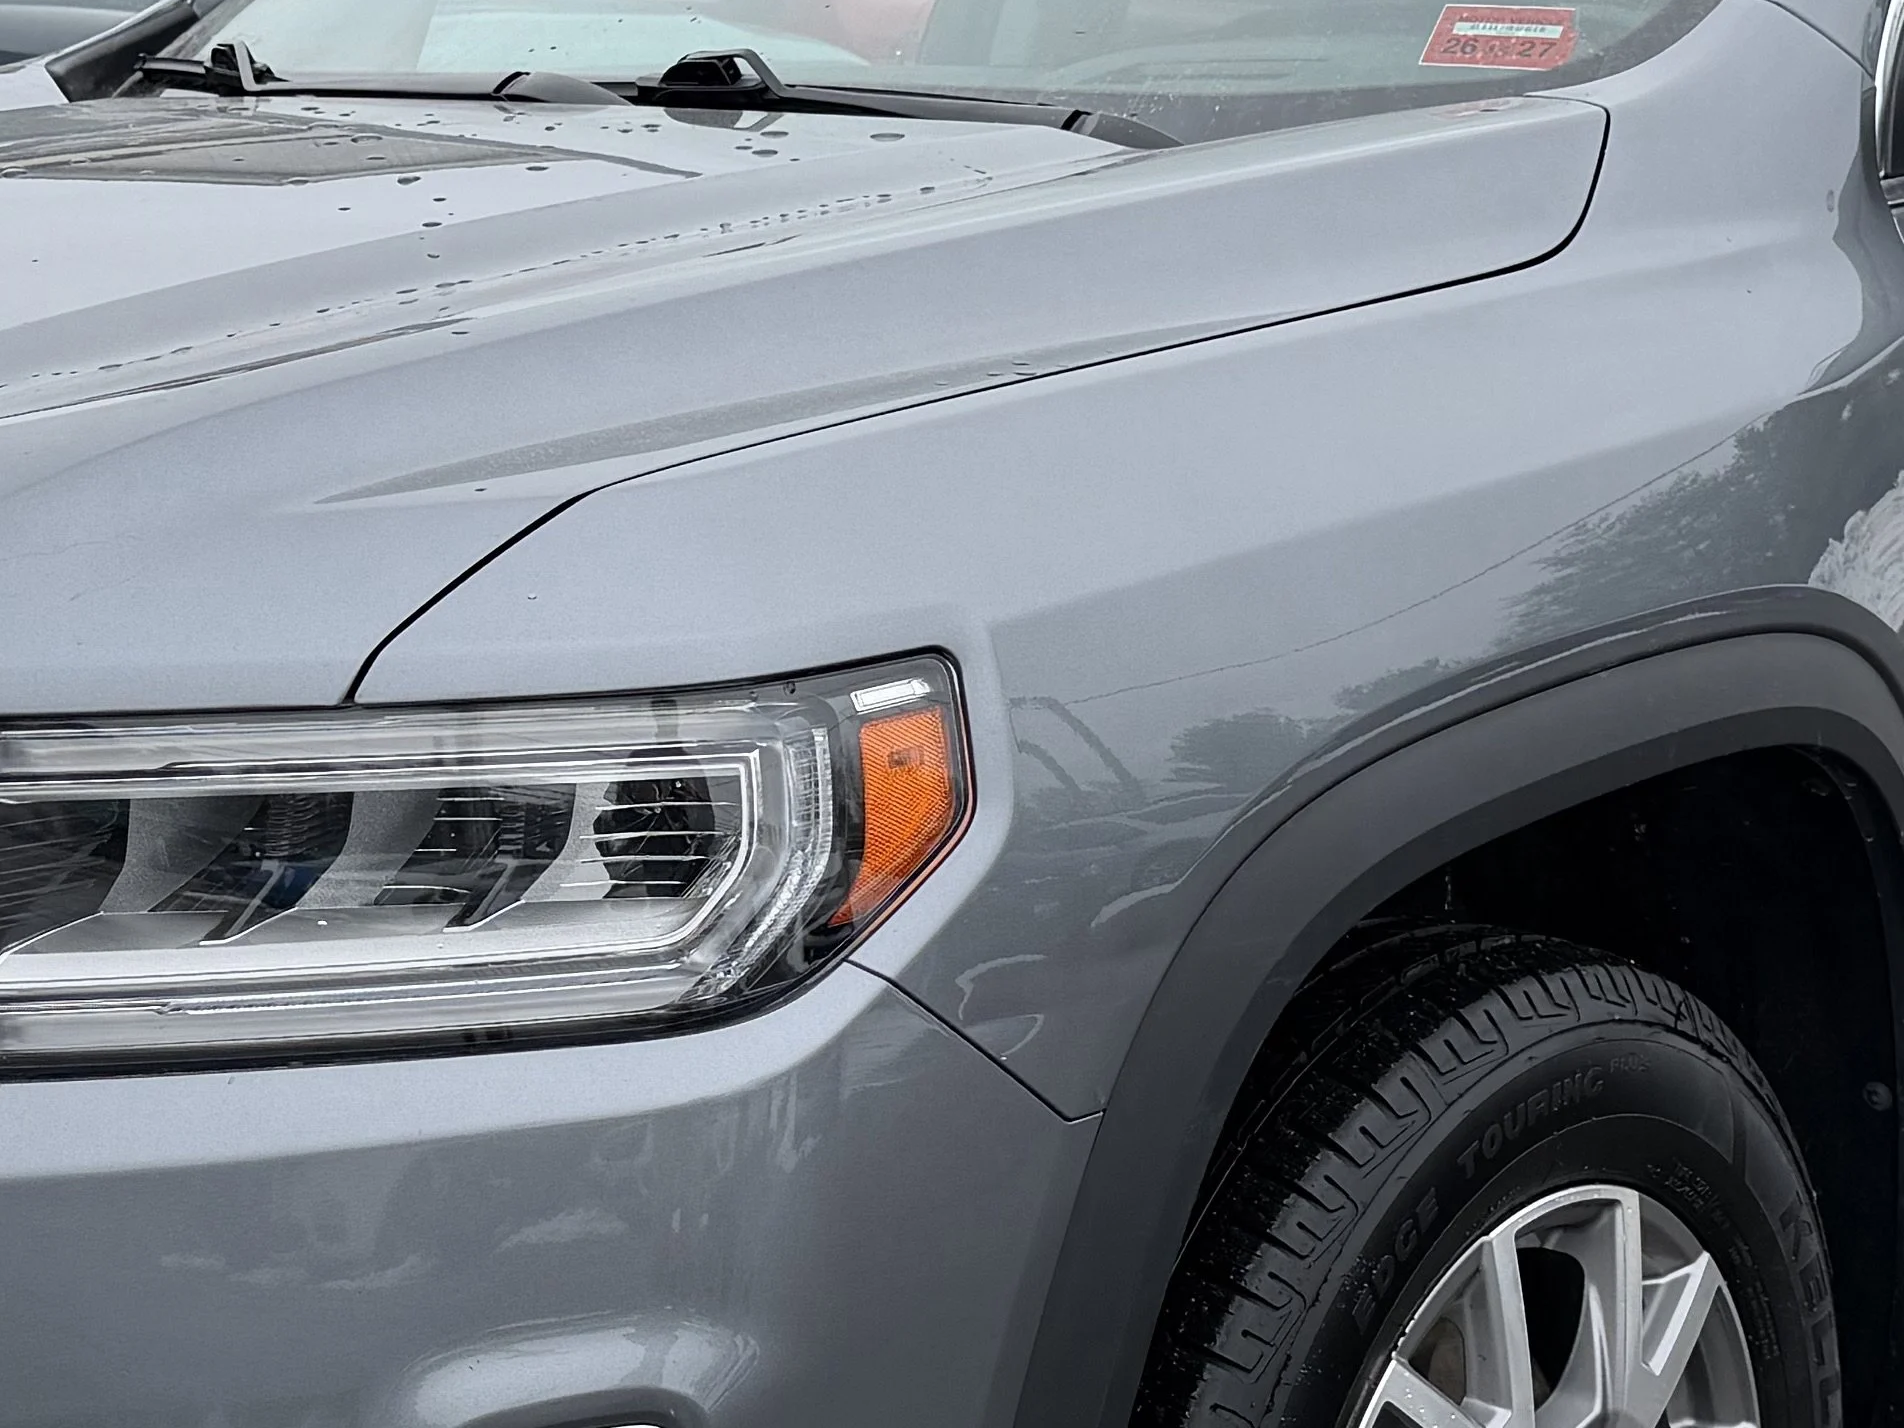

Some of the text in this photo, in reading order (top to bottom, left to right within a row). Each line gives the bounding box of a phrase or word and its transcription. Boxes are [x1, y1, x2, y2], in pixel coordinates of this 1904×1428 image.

[1441, 37, 1480, 55] 26
[1516, 40, 1557, 58] 27
[1352, 1185, 1441, 1336] EDGE
[1456, 1066, 1605, 1179] TOURING
